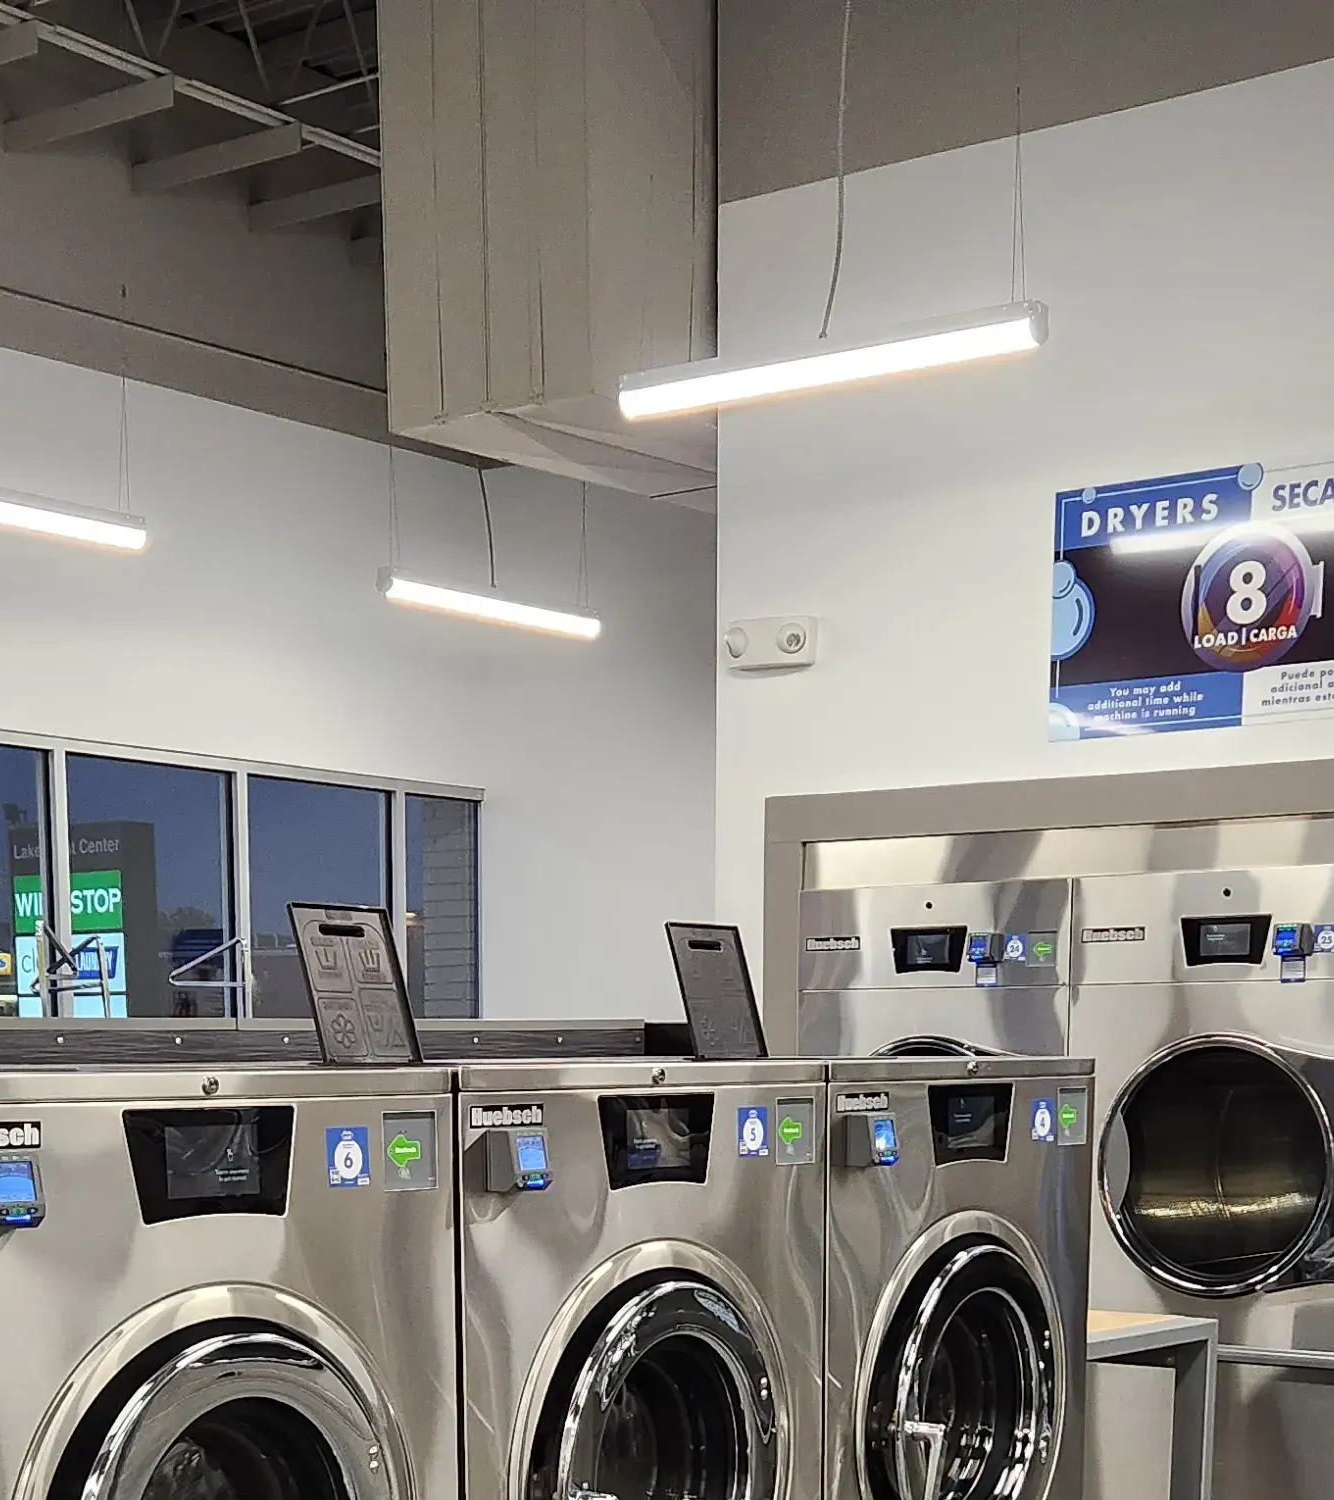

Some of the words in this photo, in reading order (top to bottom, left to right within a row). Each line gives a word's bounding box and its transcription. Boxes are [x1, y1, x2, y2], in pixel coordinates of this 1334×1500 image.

[1080, 493, 1219, 538] DRYERS
[1226, 560, 1267, 625] 8
[1194, 632, 1238, 649] LOAD
[1249, 625, 1298, 643] CARGA
[1280, 668, 1316, 681] Puede
[1110, 687, 1130, 697] You
[1133, 685, 1157, 697] may
[1159, 681, 1181, 693] add
[1270, 680, 1323, 694] adicional
[1327, 680, 1334, 689] a
[1087, 696, 1142, 711] additional
[1145, 694, 1170, 706] time
[1173, 692, 1204, 704] while
[1261, 693, 1311, 707] mientras
[1094, 709, 1137, 723] machine
[1141, 707, 1150, 719] is
[1153, 705, 1196, 717] running
[79, 837, 121, 854] Center
[1082, 927, 1144, 942] Huebsch
[1320, 935, 1333, 944] 25
[1009, 944, 1020, 953] 24
[837, 1093, 888, 1111] Huebsch
[471, 1105, 542, 1126] Huebsch
[749, 1127, 757, 1142] 5
[343, 1151, 354, 1170] 6
